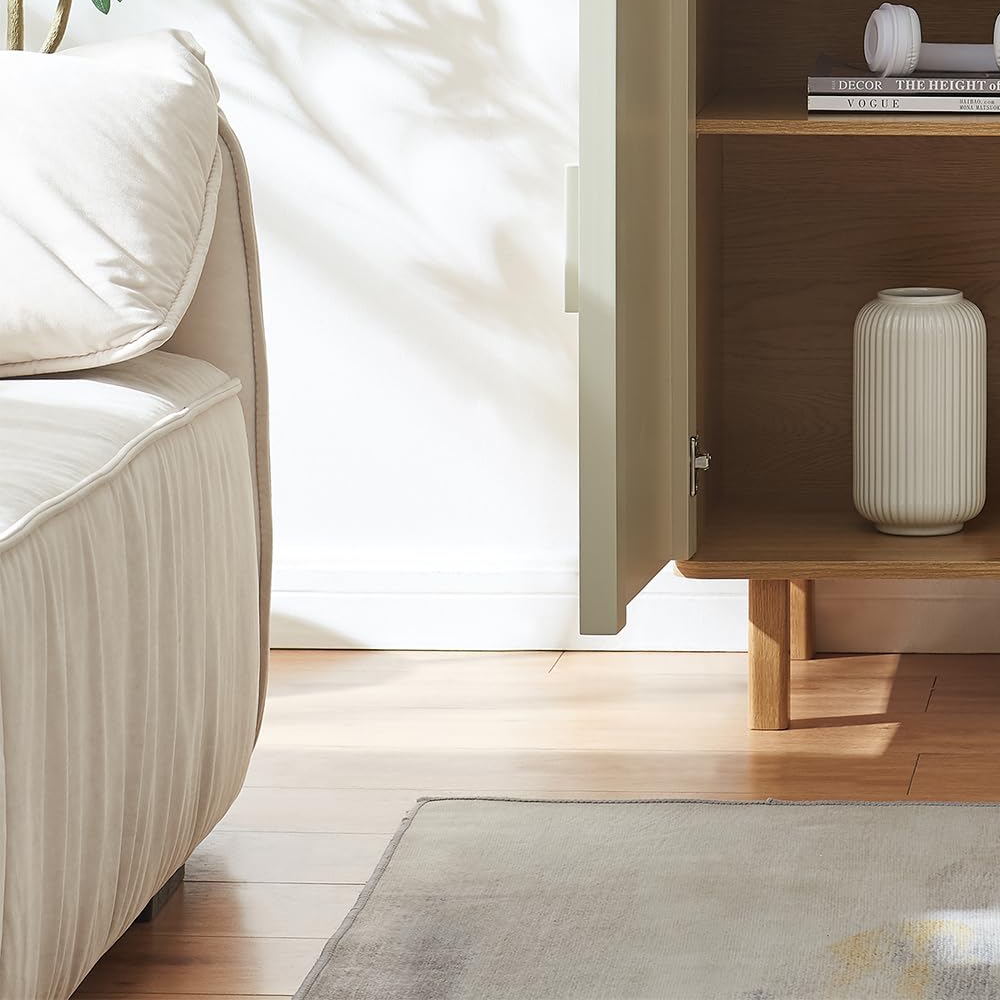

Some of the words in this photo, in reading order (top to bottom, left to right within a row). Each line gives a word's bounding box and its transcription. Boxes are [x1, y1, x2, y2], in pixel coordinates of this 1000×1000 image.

[838, 80, 883, 90] DECOR
[895, 80, 925, 90] THE
[929, 80, 987, 90] HEIGHT
[847, 99, 900, 109] VOGUE
